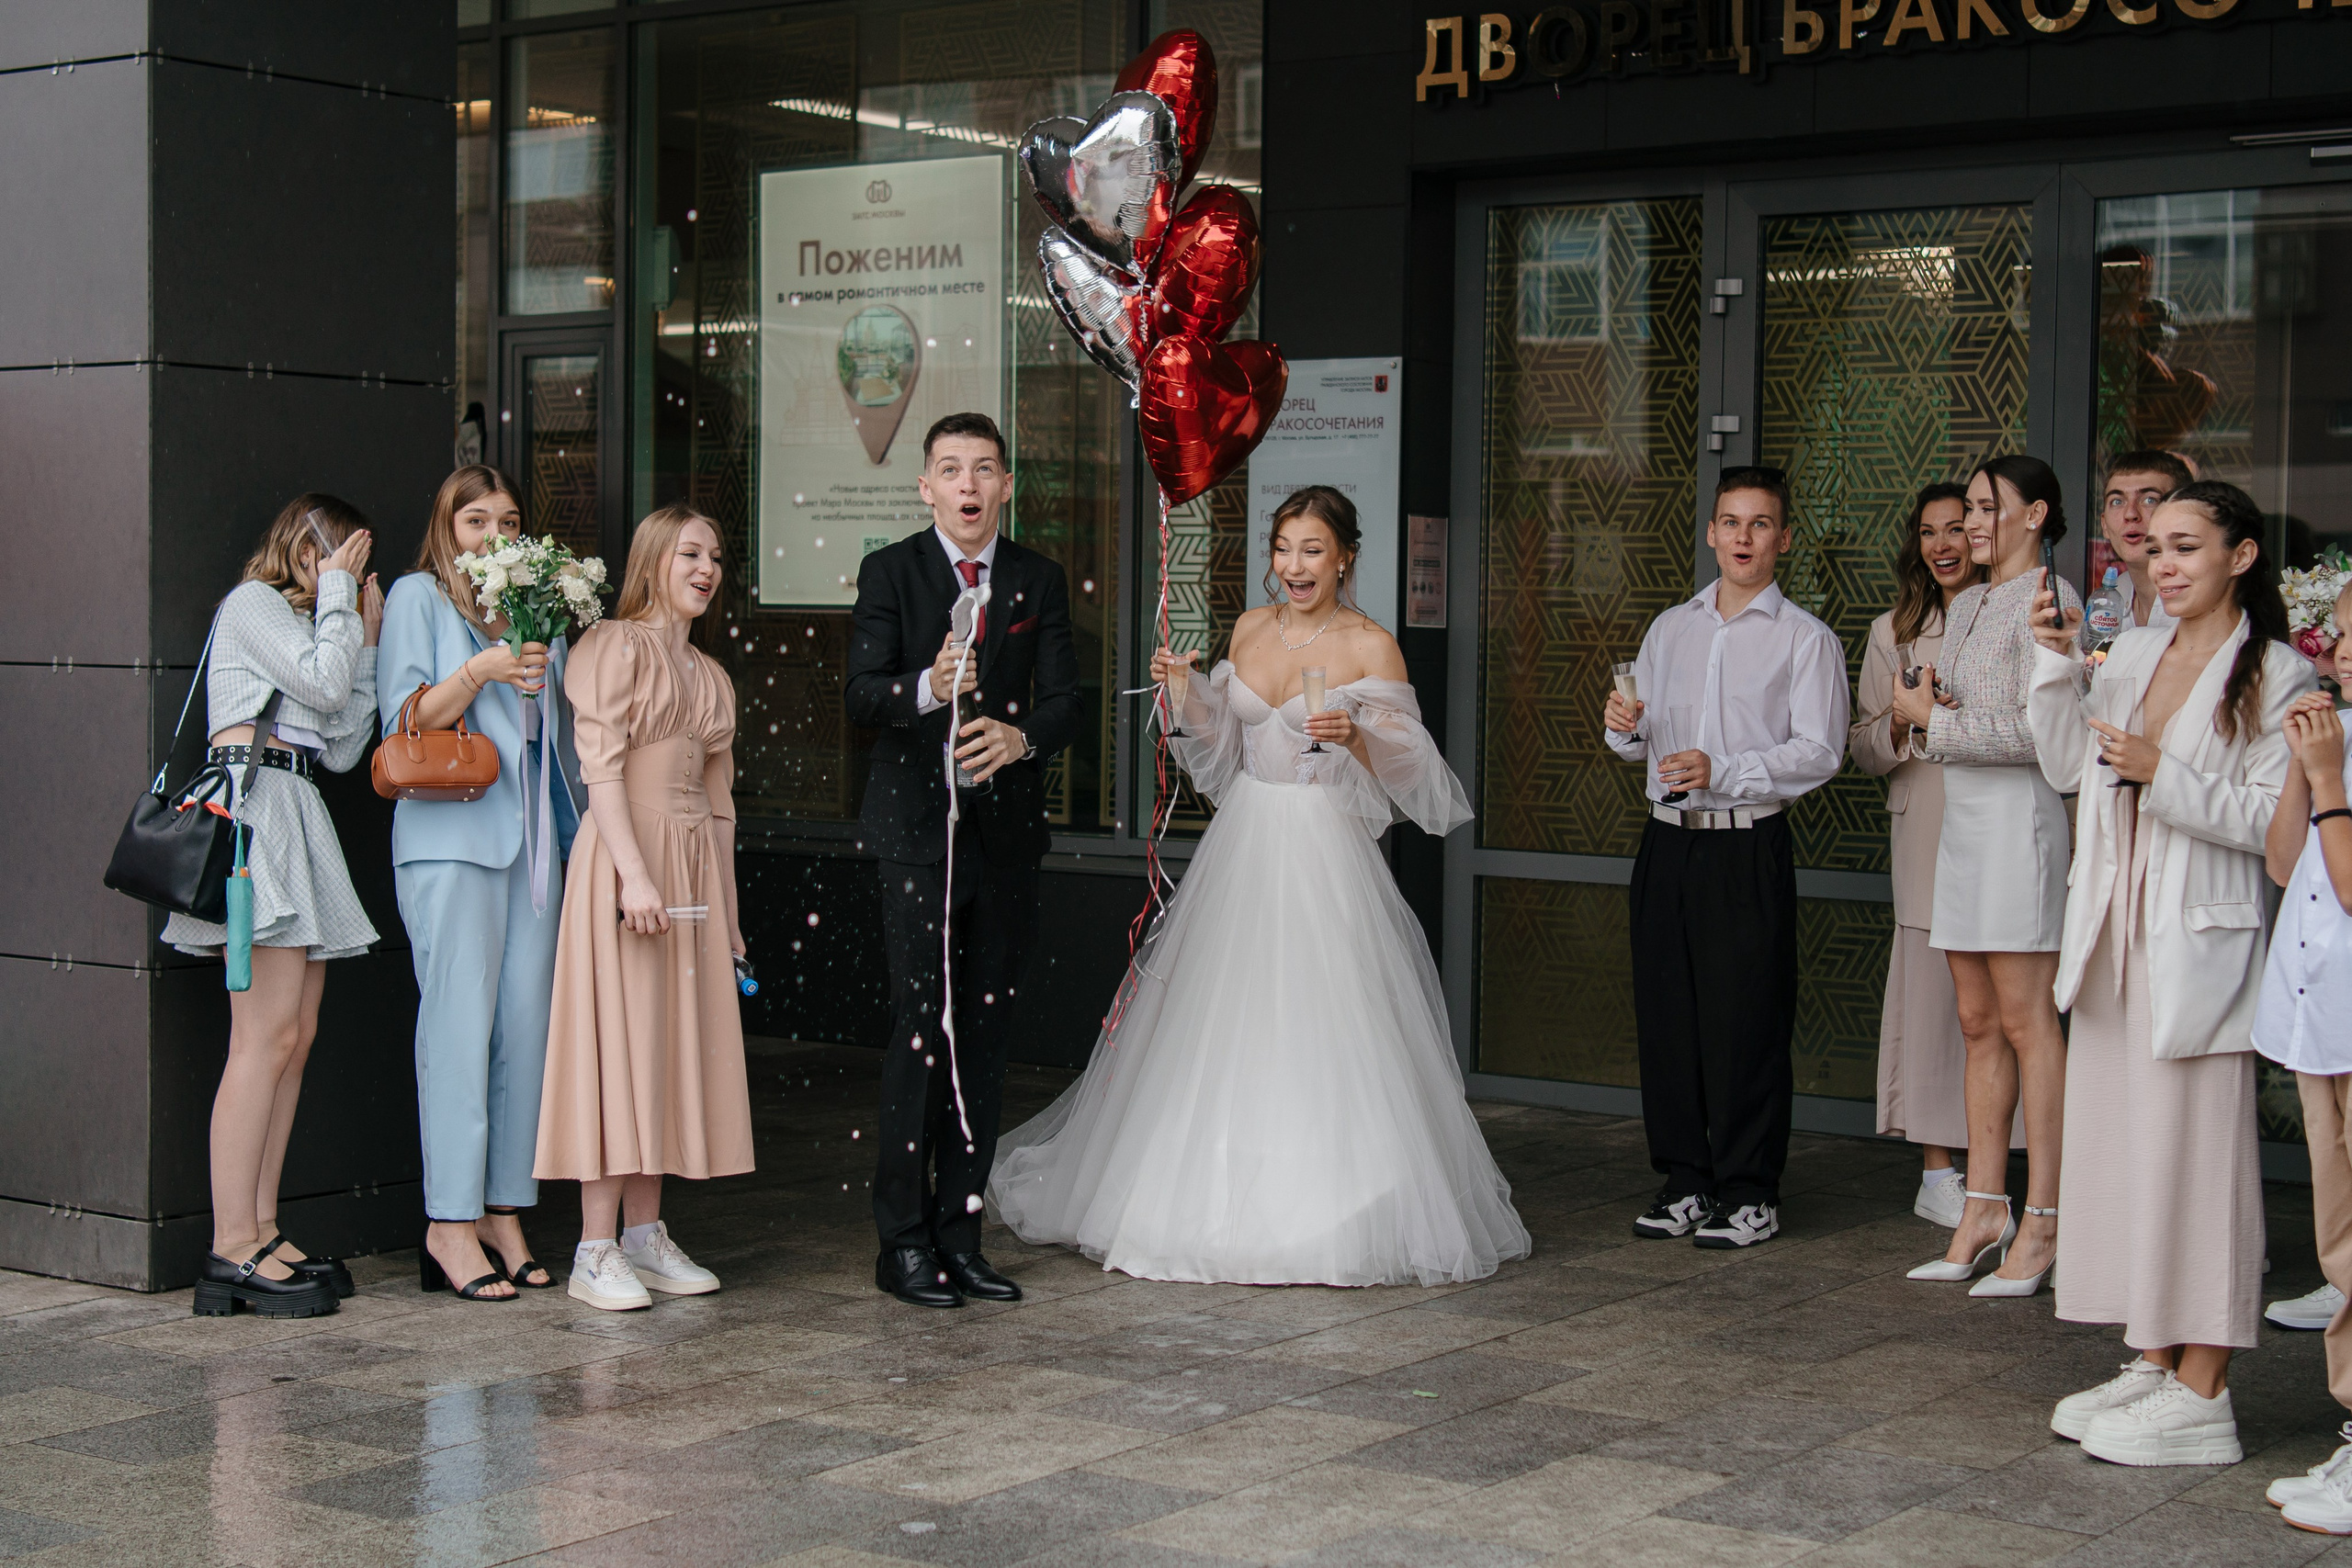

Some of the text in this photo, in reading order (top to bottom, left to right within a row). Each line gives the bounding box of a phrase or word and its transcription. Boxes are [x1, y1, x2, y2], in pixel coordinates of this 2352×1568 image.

[1416, 0, 1751, 102] ДВОРЕЦ
[798, 239, 964, 276] Поженим
[777, 292, 785, 303] в
[837, 284, 938, 304] романтичном
[942, 280, 986, 295] месте
[1280, 398, 1316, 412] ОРЕЦ
[1270, 416, 1384, 431] РАКОСОЧЕТАНИЯ
[1261, 484, 1357, 495] ВИД ДЕЯСТИ
[820, 497, 842, 508] Мэра
[844, 497, 874, 506] Москвы
[888, 499, 927, 507] заключен
[866, 513, 910, 522] площадах
